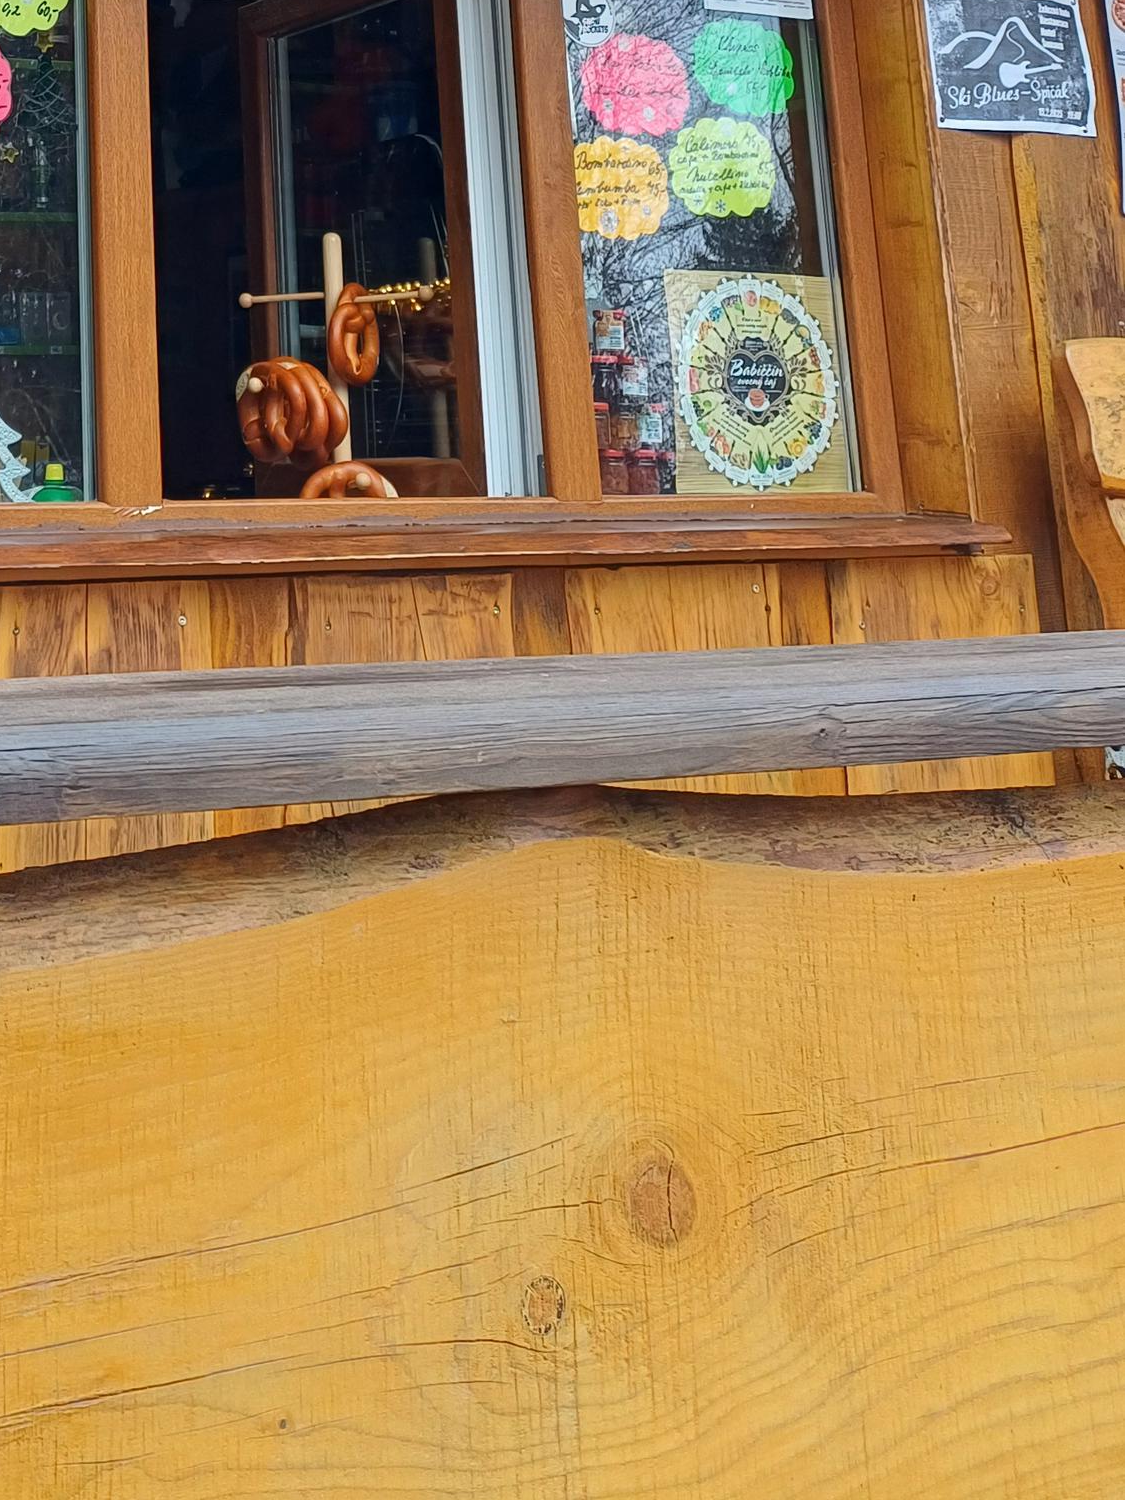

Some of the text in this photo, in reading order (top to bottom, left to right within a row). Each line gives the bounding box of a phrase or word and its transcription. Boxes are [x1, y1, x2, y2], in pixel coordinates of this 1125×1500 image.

[1, 2, 22, 18] 0,2
[36, 0, 60, 22] 60,-
[947, 85, 972, 109] Ski
[730, 358, 785, 378] Babiččin
